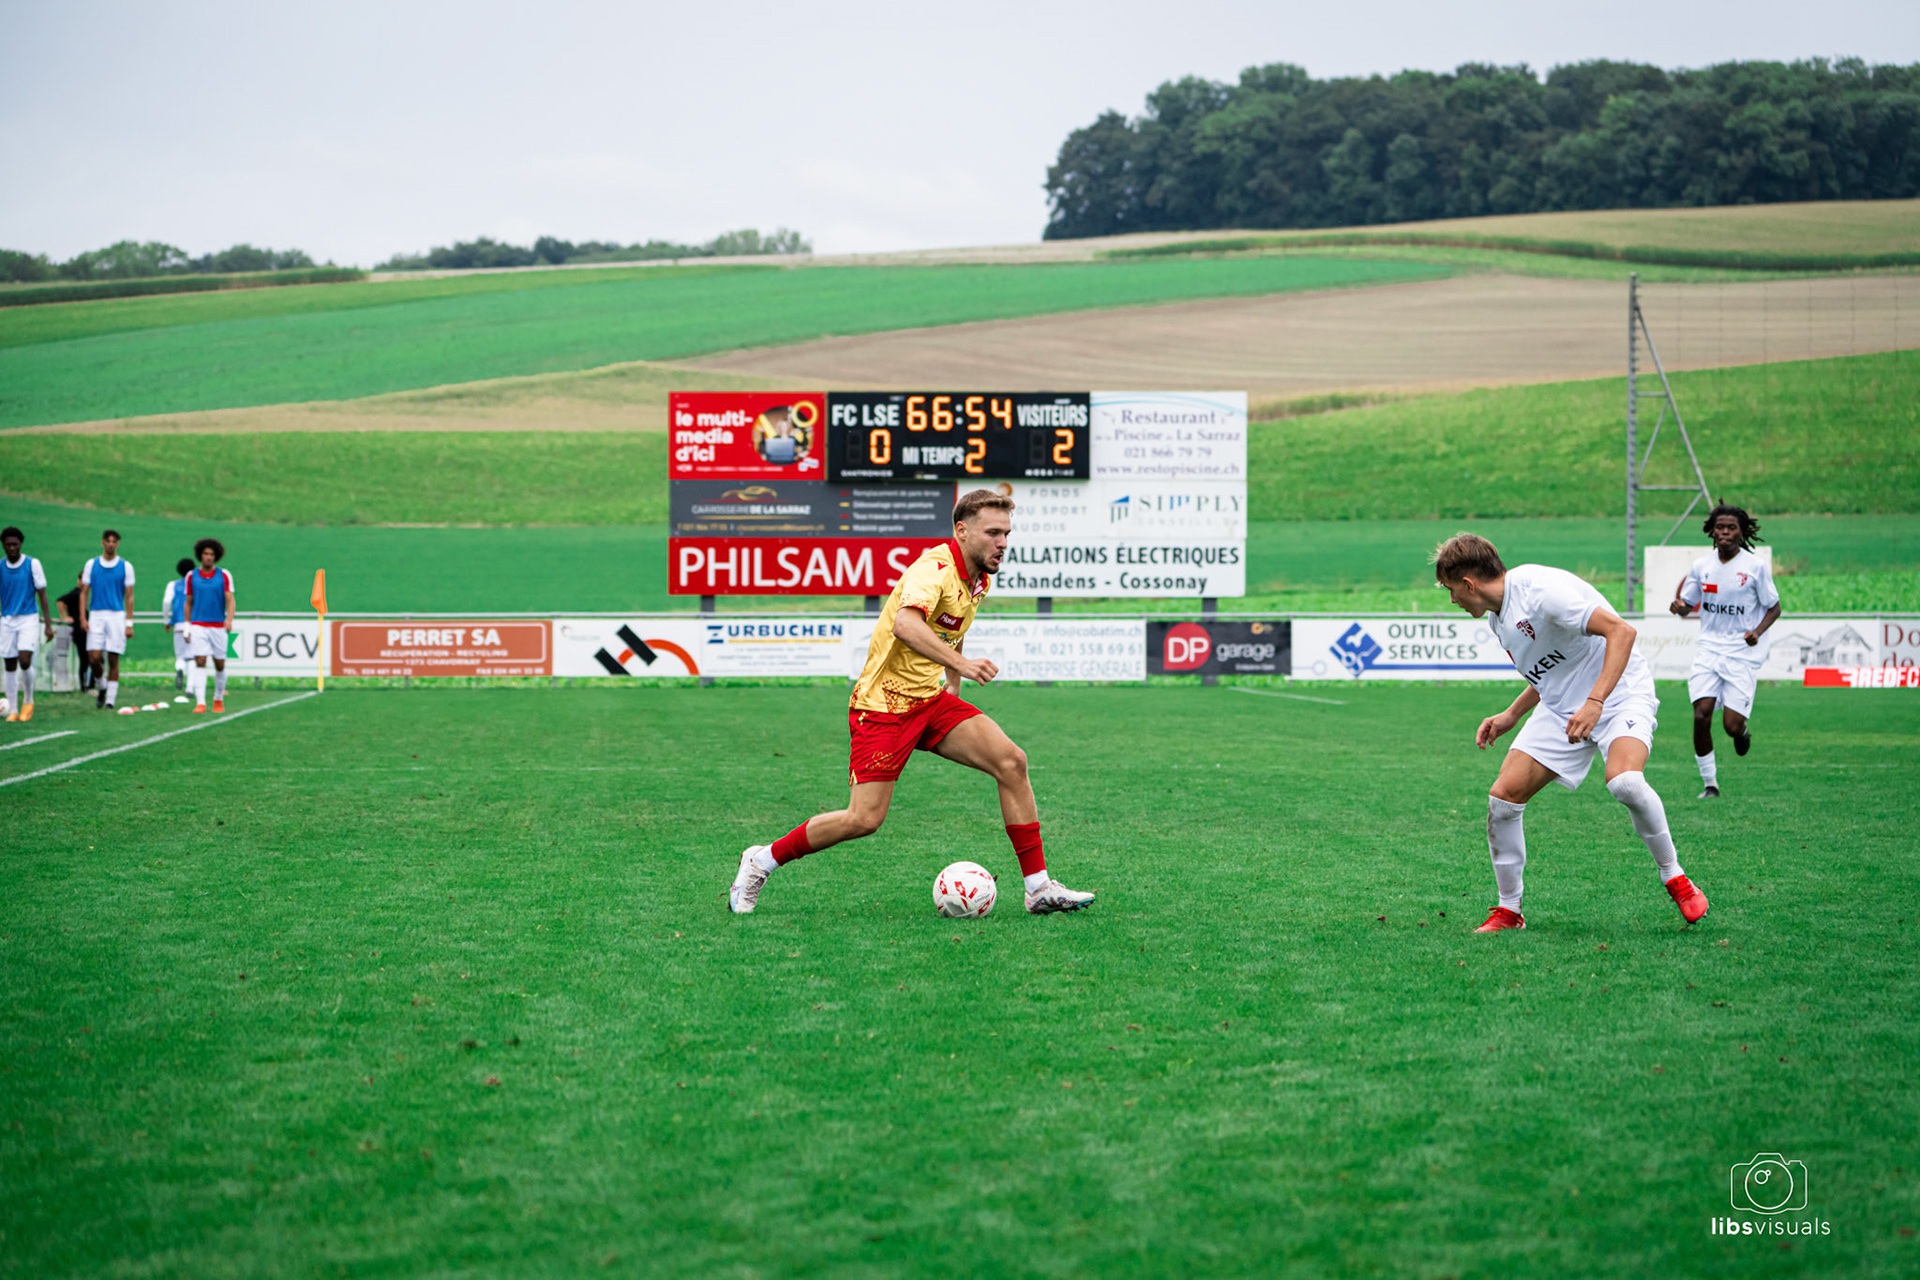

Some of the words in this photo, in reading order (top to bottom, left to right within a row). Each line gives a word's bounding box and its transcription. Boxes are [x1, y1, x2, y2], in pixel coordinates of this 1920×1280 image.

[676, 410, 693, 427] le
[697, 410, 753, 427] multi-
[832, 404, 857, 426] FC
[862, 404, 900, 426] LSE
[906, 396, 1012, 431] 66:54
[1017, 404, 1088, 427] VISITEURS
[1122, 410, 1215, 424] Restaurant
[676, 428, 734, 444] media
[1114, 429, 1162, 441] Piscine
[1177, 430, 1192, 441] La
[1198, 429, 1240, 441] Sarraz
[675, 445, 715, 462] d'ici
[870, 429, 891, 464] 0
[1053, 429, 1074, 464] 2
[1124, 447, 1146, 458] 021
[902, 447, 920, 466] MI
[921, 447, 965, 466] TEMPS
[965, 438, 986, 474] 2
[1097, 463, 1240, 477] www.restopiscine.ch
[1030, 488, 1079, 497] FONDS
[763, 505, 775, 514] LA
[1042, 506, 1087, 515] SPORT
[1116, 543, 1240, 568] ÉLECTRIQUES
[679, 547, 874, 587] PHILSAM
[886, 546, 930, 588] S
[996, 572, 1096, 589] Echandens
[1119, 572, 1207, 594] Cossonay
[387, 629, 466, 646] PERRET
[471, 629, 501, 646] SA
[1042, 624, 1142, 637] info@cobatim.ch
[1388, 624, 1457, 639] OUTILS
[254, 632, 319, 658] BCV
[1050, 643, 1073, 655] 021
[1168, 637, 1209, 662] DP
[1216, 644, 1275, 662] garage
[1388, 645, 1478, 660] SERVICES
[1007, 661, 1076, 677] ENTREPRISE
